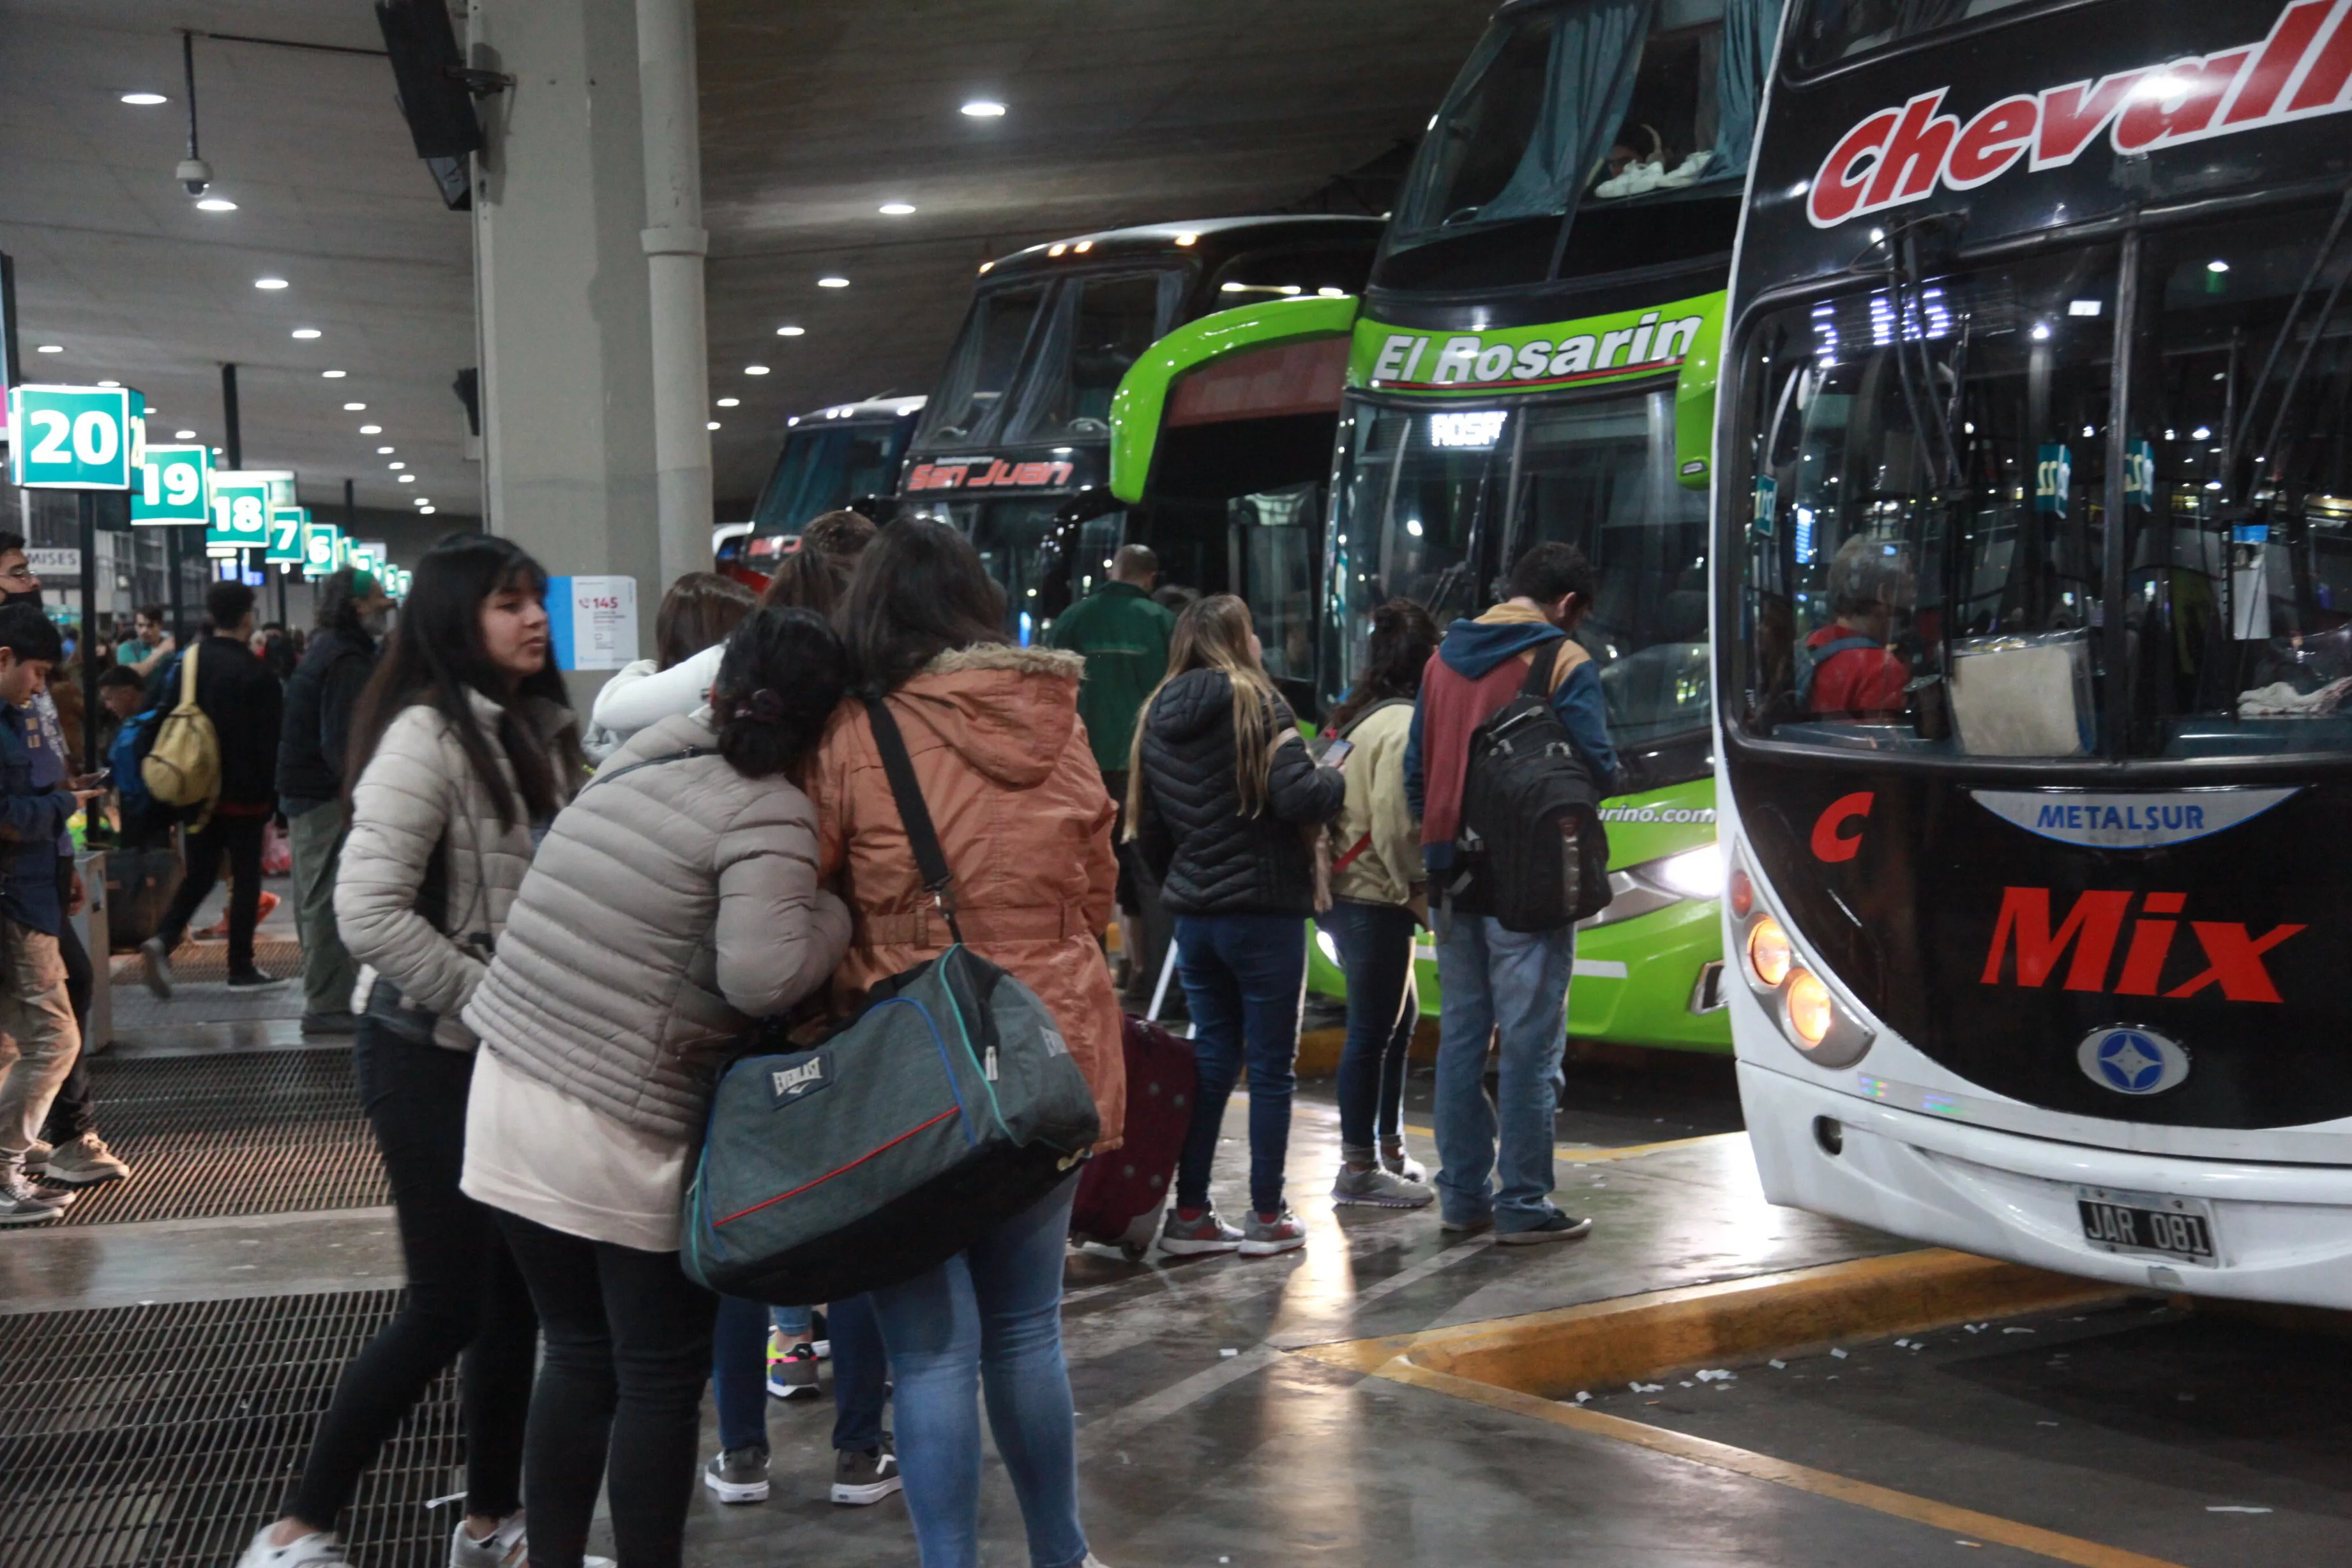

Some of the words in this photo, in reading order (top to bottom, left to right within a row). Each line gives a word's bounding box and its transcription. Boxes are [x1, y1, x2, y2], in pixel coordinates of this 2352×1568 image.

[1372, 334, 1432, 382] El
[31, 410, 118, 465] 20
[144, 463, 199, 506] 19
[907, 463, 970, 491] San
[967, 459, 1075, 487] Juan
[215, 496, 263, 533] 18
[593, 597, 619, 609] 145
[2037, 805, 2204, 831] METALSUR
[1980, 886, 2308, 1003] Mix
[2087, 1204, 2138, 1245] JAR
[2149, 1213, 2210, 1254] 081
